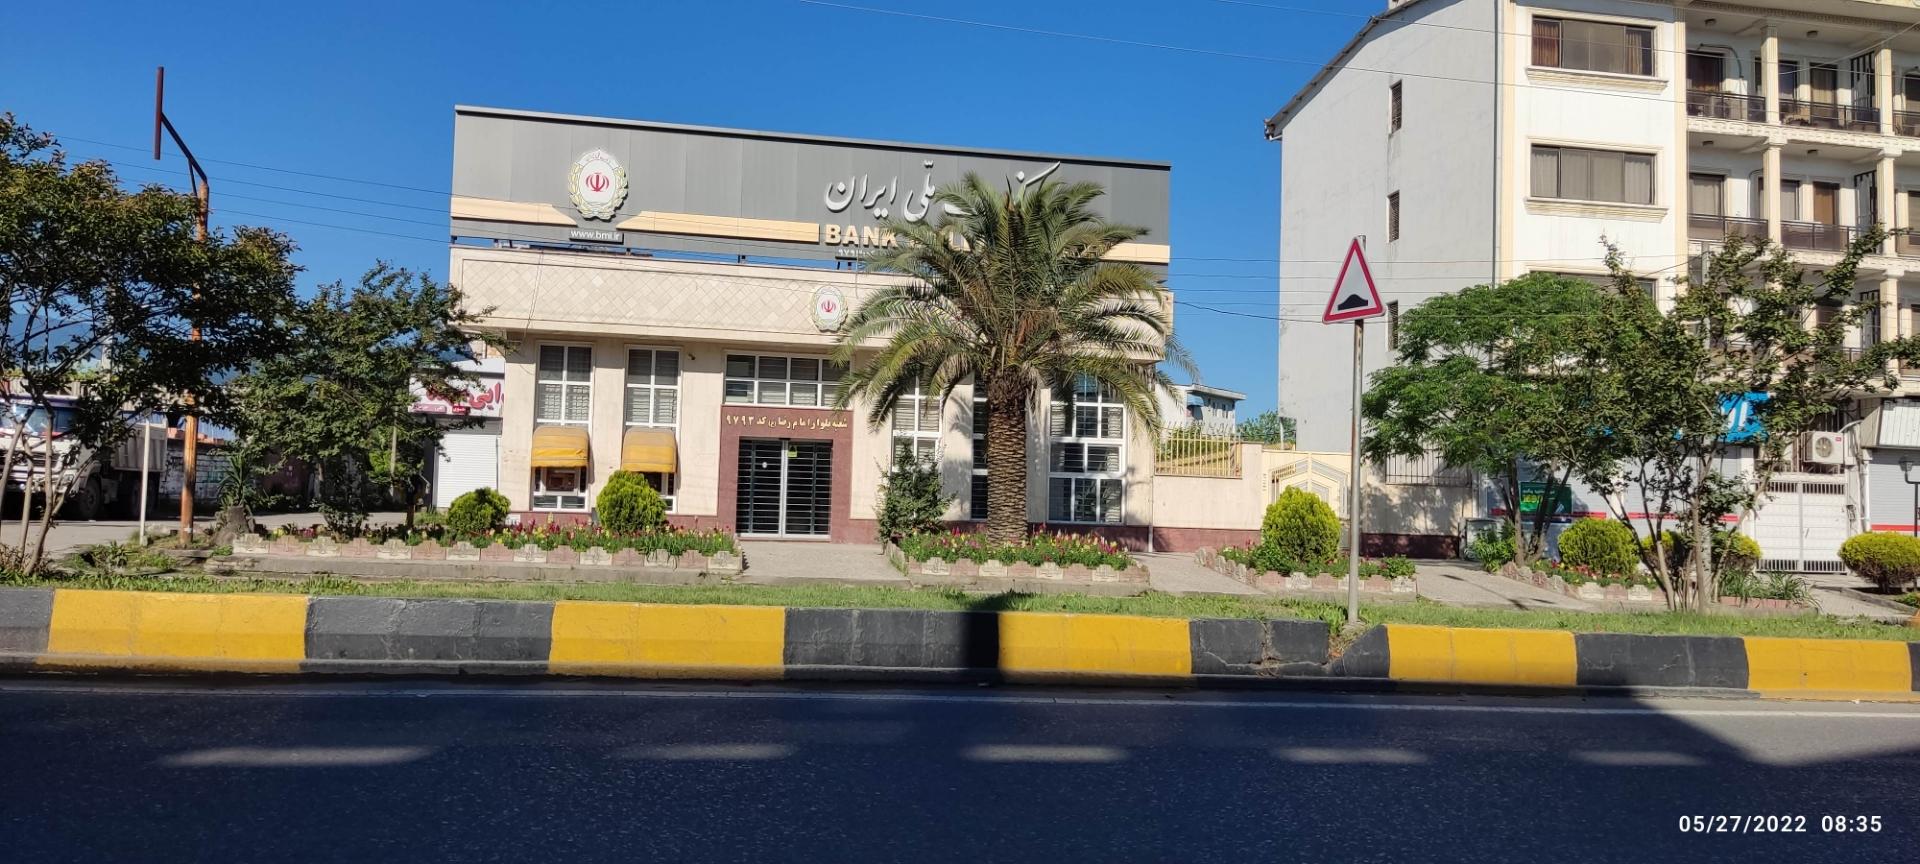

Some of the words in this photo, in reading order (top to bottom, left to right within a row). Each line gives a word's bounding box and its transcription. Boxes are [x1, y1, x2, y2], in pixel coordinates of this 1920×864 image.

[823, 173, 899, 219] ایران
[570, 229, 620, 241] www.bmi.ir
[825, 223, 898, 248] BANK
[831, 417, 848, 432] شعبه
